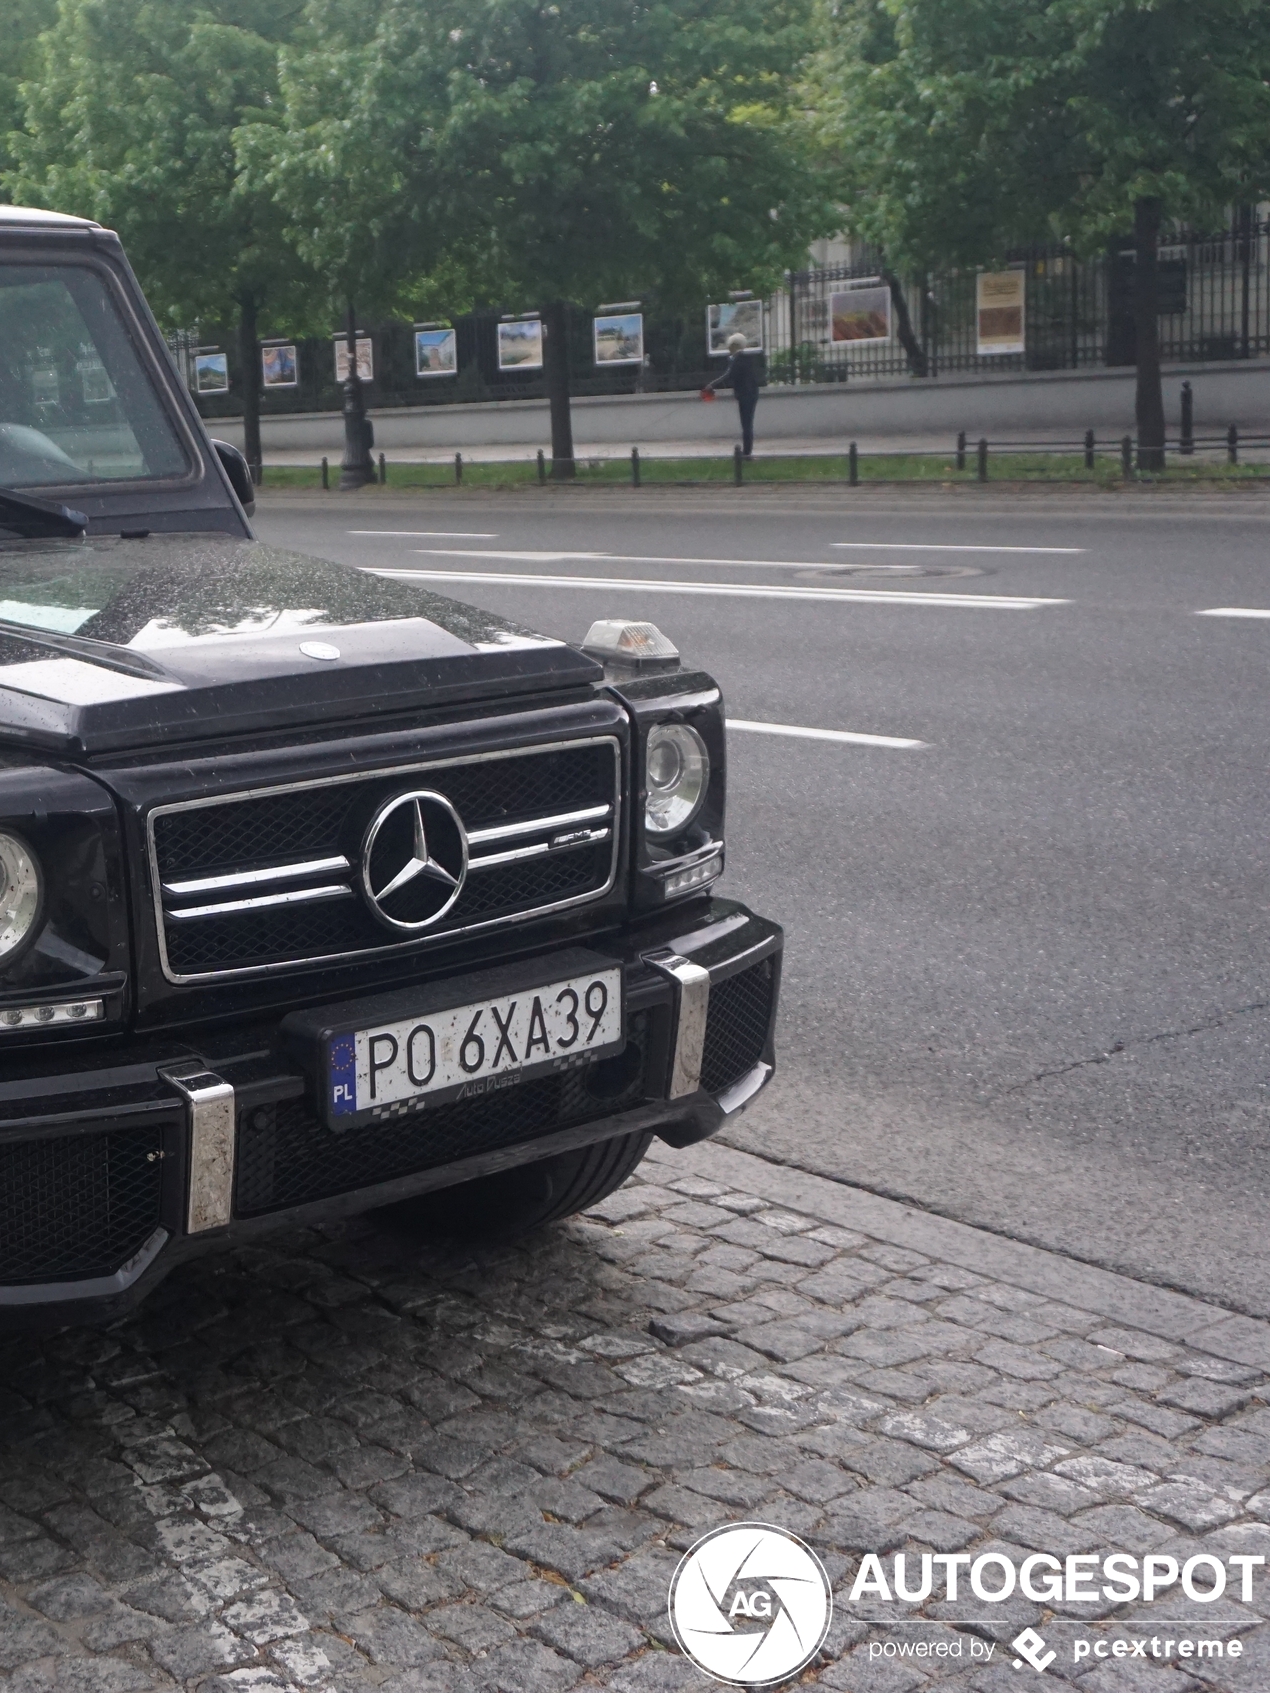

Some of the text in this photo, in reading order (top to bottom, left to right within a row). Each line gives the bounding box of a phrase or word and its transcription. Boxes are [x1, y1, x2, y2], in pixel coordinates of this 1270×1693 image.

[368, 980, 608, 1100] PO 6XA39
[333, 1083, 352, 1103] PL
[455, 1083, 484, 1100] Auto
